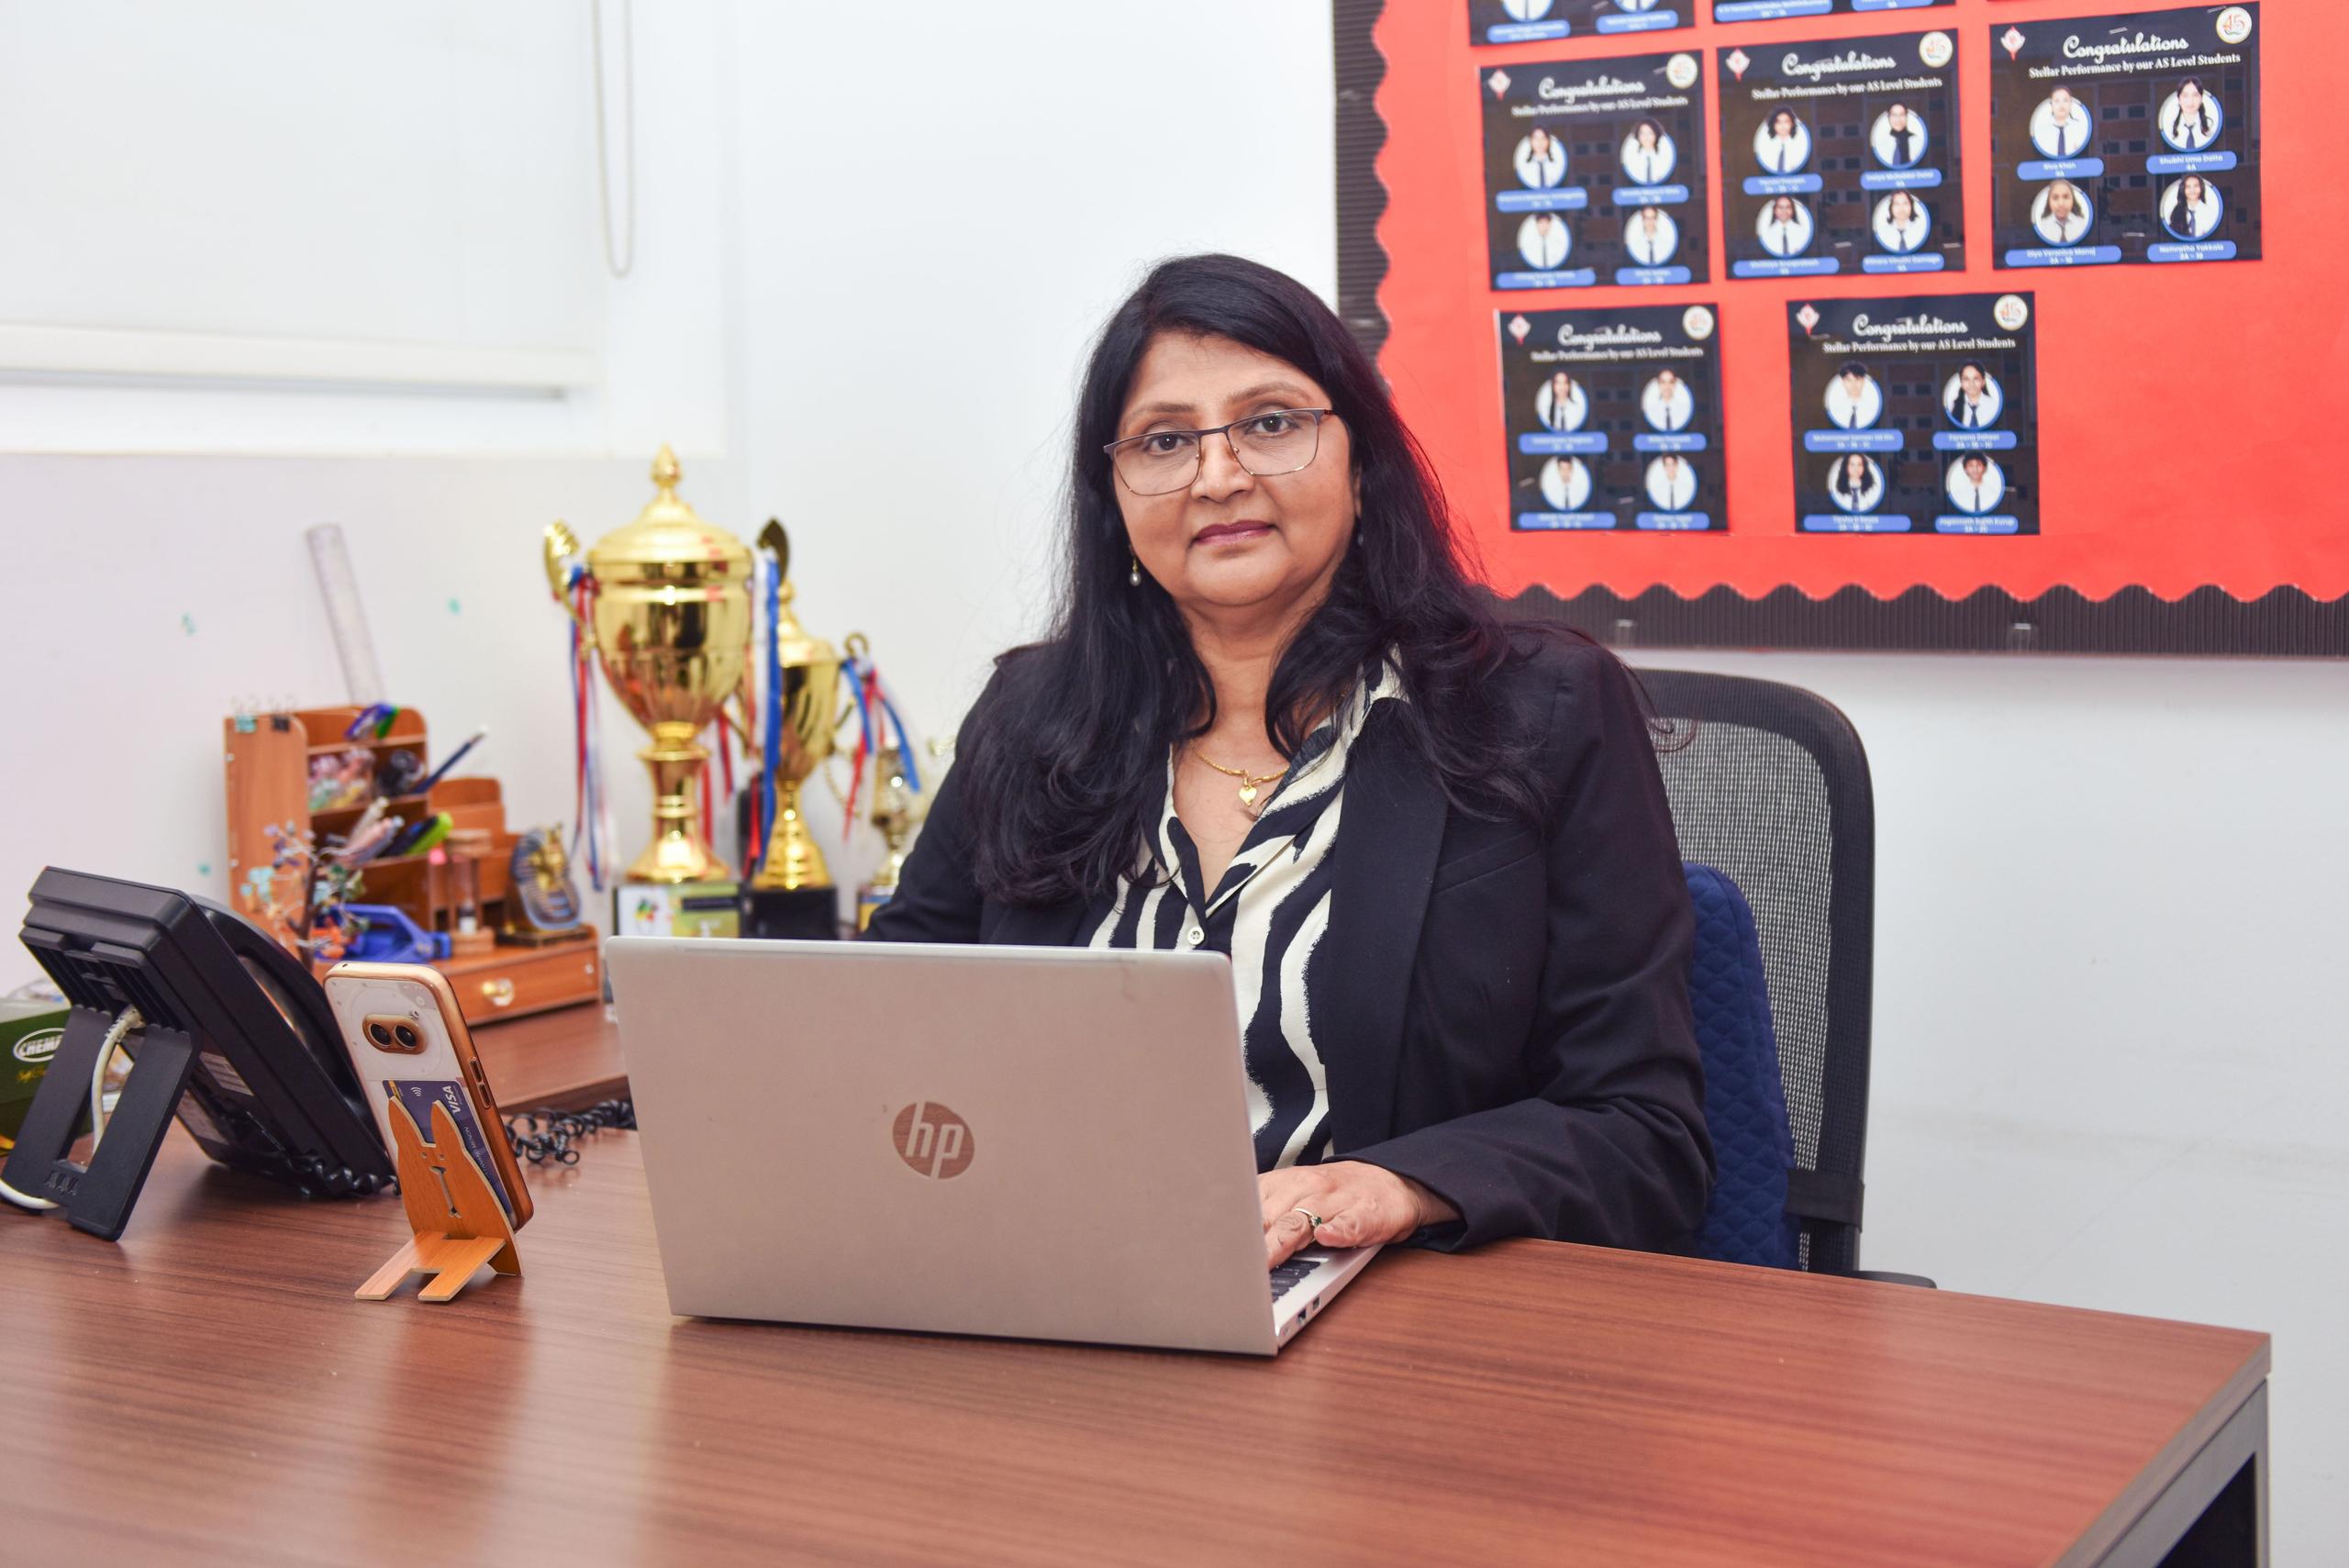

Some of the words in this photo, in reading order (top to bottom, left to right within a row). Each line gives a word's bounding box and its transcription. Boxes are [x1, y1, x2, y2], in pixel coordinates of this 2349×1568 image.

[2063, 32, 2189, 64] Congratulations
[1782, 50, 1897, 82] Congratulations
[2029, 65, 2059, 79] Stellar
[2061, 62, 2122, 76] Performance
[2122, 60, 2134, 73] by
[2135, 60, 2154, 71] our
[2154, 57, 2169, 69] AS
[2171, 55, 2197, 68] Level
[2198, 52, 2242, 65] Students
[1539, 75, 1646, 105] Congratulations
[1781, 85, 1836, 98] Performance
[1836, 83, 1847, 97] by
[1848, 83, 1865, 94] our
[1866, 81, 1880, 92] AS
[1880, 79, 1903, 91] Level
[1903, 76, 1943, 89] Students
[1557, 324, 1662, 351] Congratulations
[1853, 313, 1968, 343] Congratulations
[1822, 341, 1851, 354] Stellar
[1852, 340, 1908, 352] Performance
[1908, 339, 1919, 353] by
[1920, 341, 1936, 350] our
[1938, 339, 1951, 350] AS
[1952, 338, 1976, 350] Level
[1976, 336, 2016, 349] Students
[442, 1085, 462, 1114] VISA
[905, 1101, 964, 1180] hp
